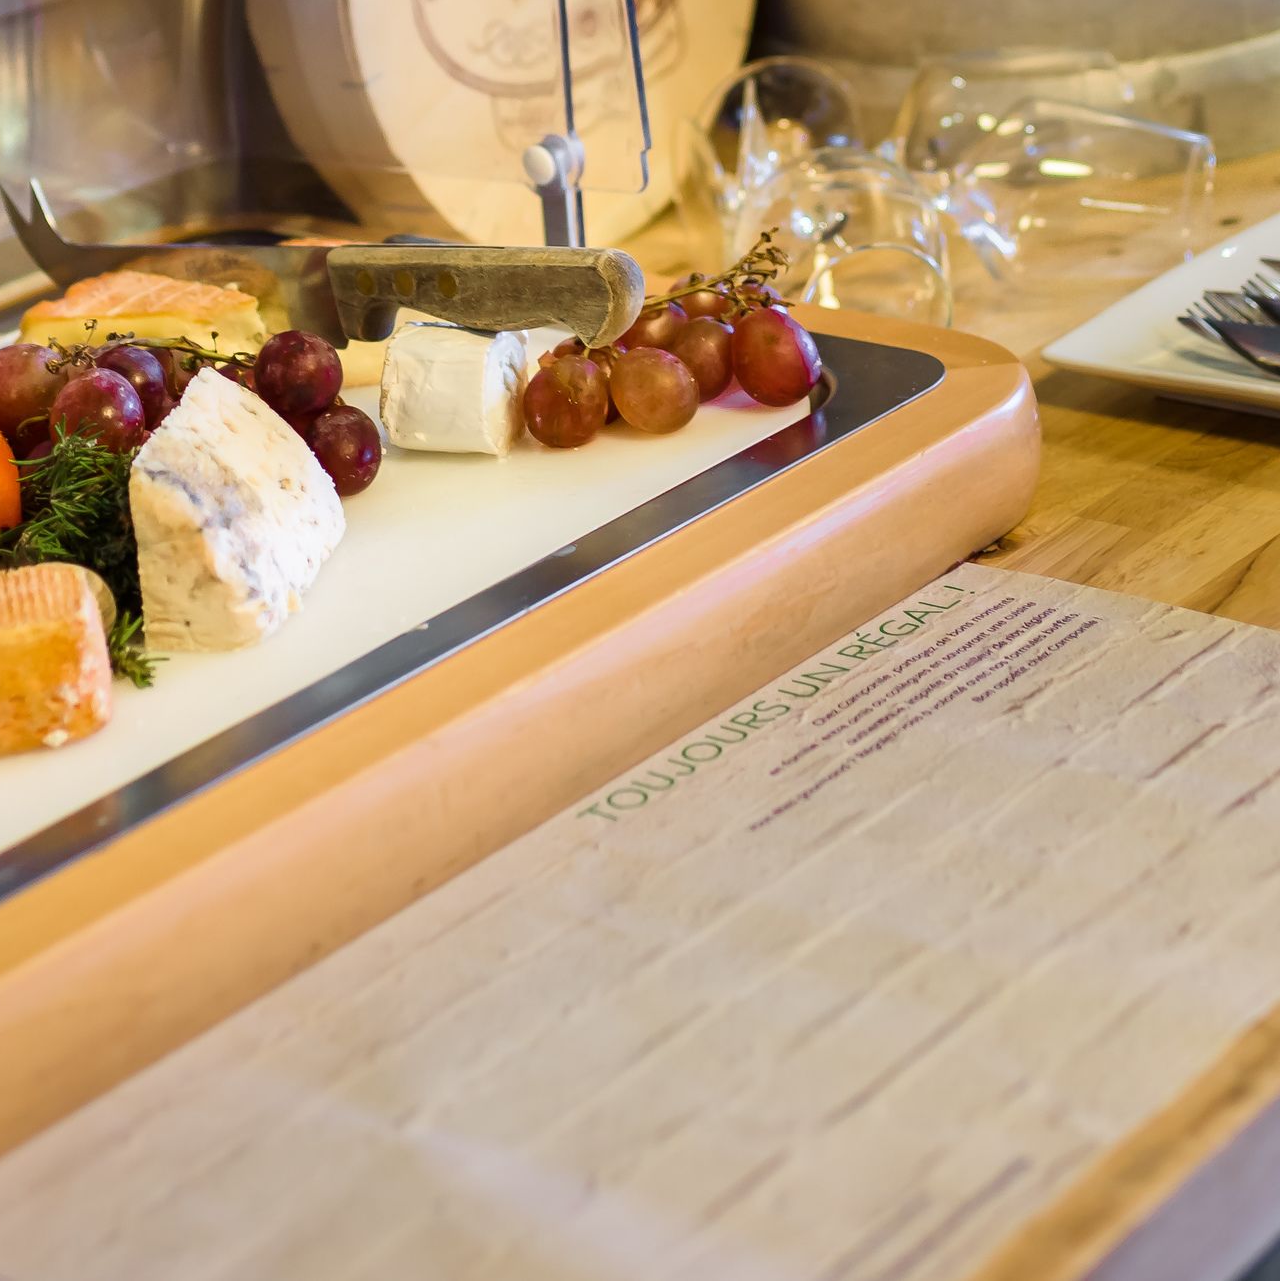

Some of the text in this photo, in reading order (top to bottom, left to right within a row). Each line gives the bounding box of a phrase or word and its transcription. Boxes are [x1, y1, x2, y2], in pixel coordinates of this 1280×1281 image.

[936, 636, 952, 647] de
[946, 621, 974, 638] bons
[972, 597, 1015, 623] moments
[942, 631, 991, 661] savourant
[987, 620, 1007, 633] une
[1004, 601, 1037, 621] cuisine
[965, 670, 993, 687] avec
[988, 660, 1009, 672] nos
[1003, 633, 1048, 661] formules
[1040, 611, 1081, 635] buffets.
[991, 639, 1008, 650] de
[1004, 629, 1025, 642] nos
[1027, 650, 1051, 667] chez
[1047, 619, 1099, 652] Campanile
[576, 585, 976, 822] TOUJOURS UN RÉGAL !
